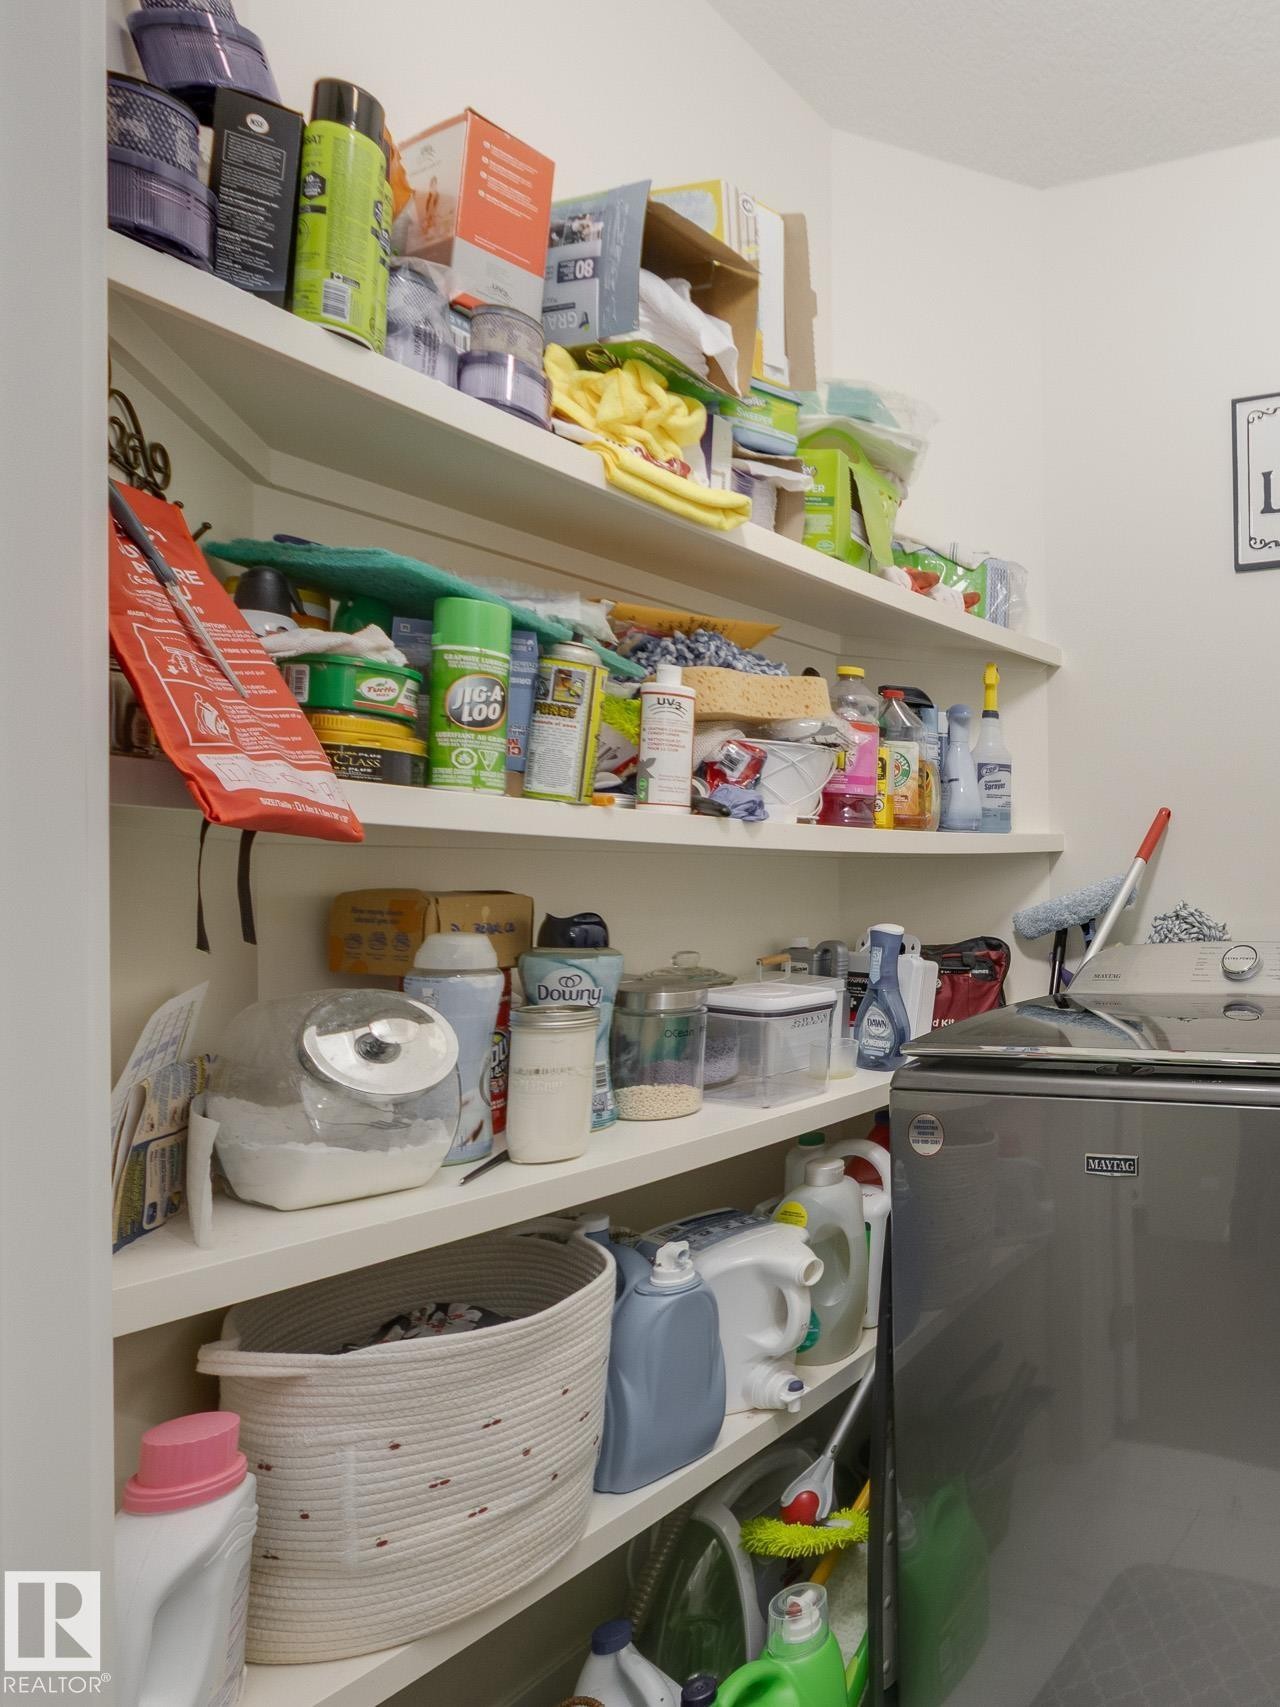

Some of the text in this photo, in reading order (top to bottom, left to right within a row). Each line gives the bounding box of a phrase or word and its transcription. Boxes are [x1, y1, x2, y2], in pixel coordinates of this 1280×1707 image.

[575, 258, 595, 279] 80
[656, 697, 682, 711] UV3
[461, 703, 501, 722] LOO
[333, 752, 382, 768] CLASS
[537, 984, 602, 1007] Downy
[866, 1017, 887, 1029] DAWN
[1087, 1158, 1135, 1172] MAYTAG
